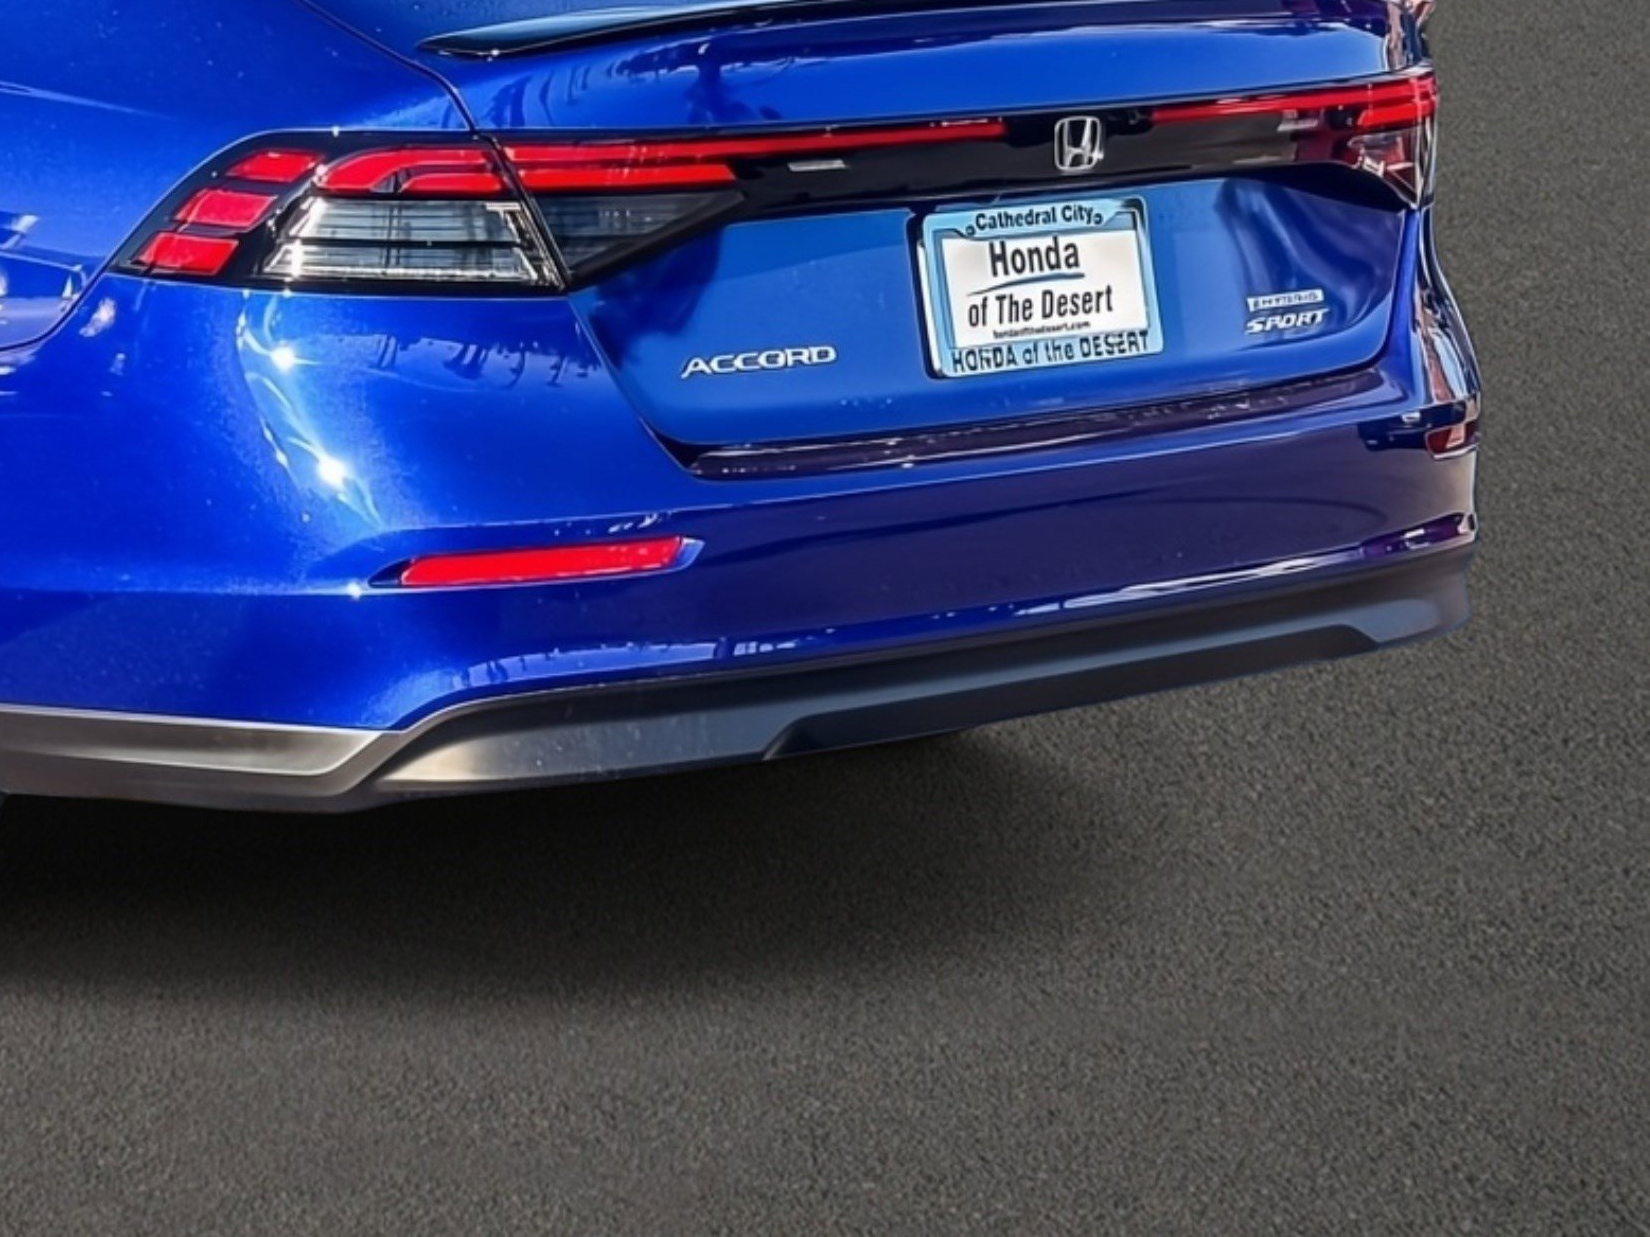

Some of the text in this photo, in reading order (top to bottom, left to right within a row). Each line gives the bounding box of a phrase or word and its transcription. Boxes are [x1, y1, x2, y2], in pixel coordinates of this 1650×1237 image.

[975, 204, 1095, 232] Cathedral City
[988, 236, 1080, 278] Honda
[995, 293, 1033, 325] The
[1041, 284, 1113, 320] Desert
[1245, 308, 1330, 335] SPORT
[680, 344, 838, 380] ACCORD
[951, 344, 1018, 374] HONDA
[1044, 337, 1075, 363] the
[1079, 330, 1150, 359] DESERT
